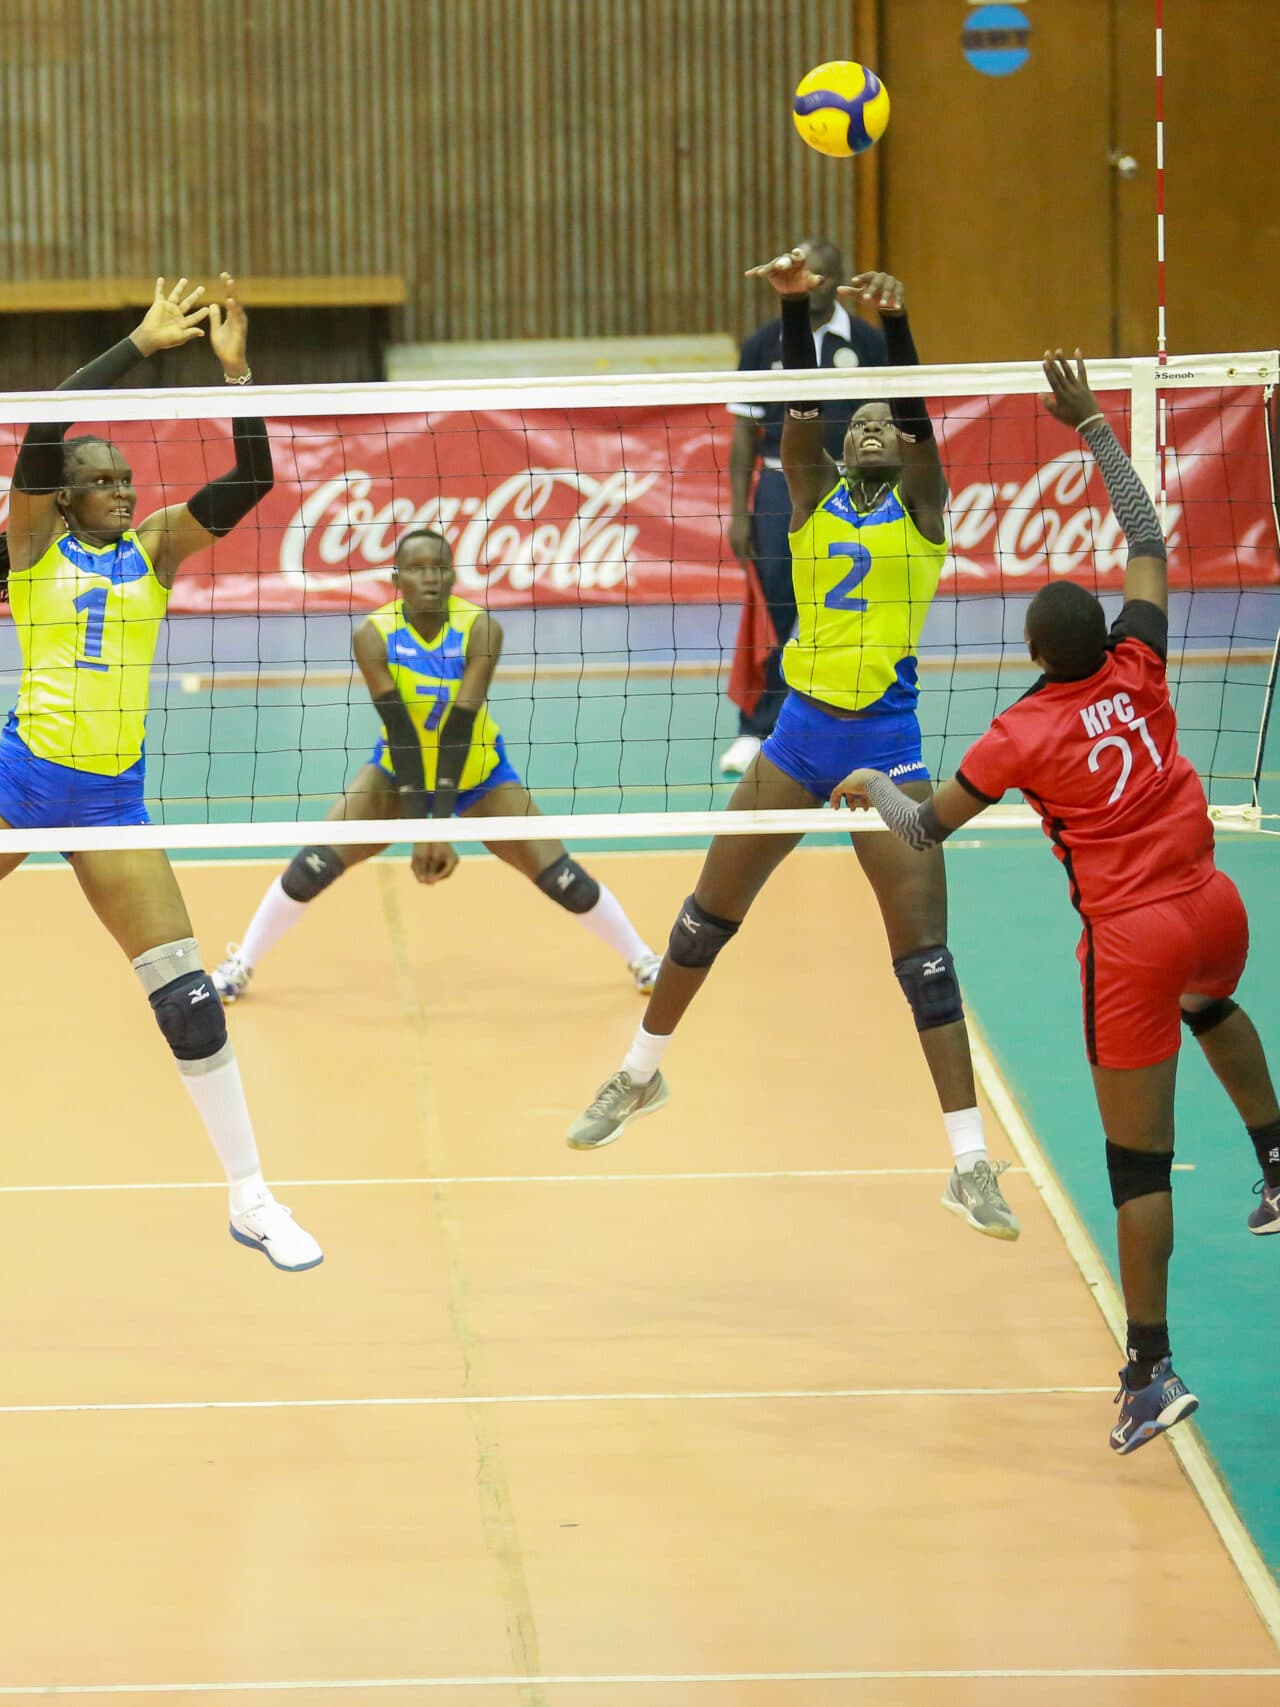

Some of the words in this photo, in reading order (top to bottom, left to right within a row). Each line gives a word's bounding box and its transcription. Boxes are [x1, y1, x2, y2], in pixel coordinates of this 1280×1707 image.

[824, 542, 872, 612] 2
[73, 587, 108, 658] 1
[415, 686, 450, 731] 7
[1080, 692, 1135, 738] KPC
